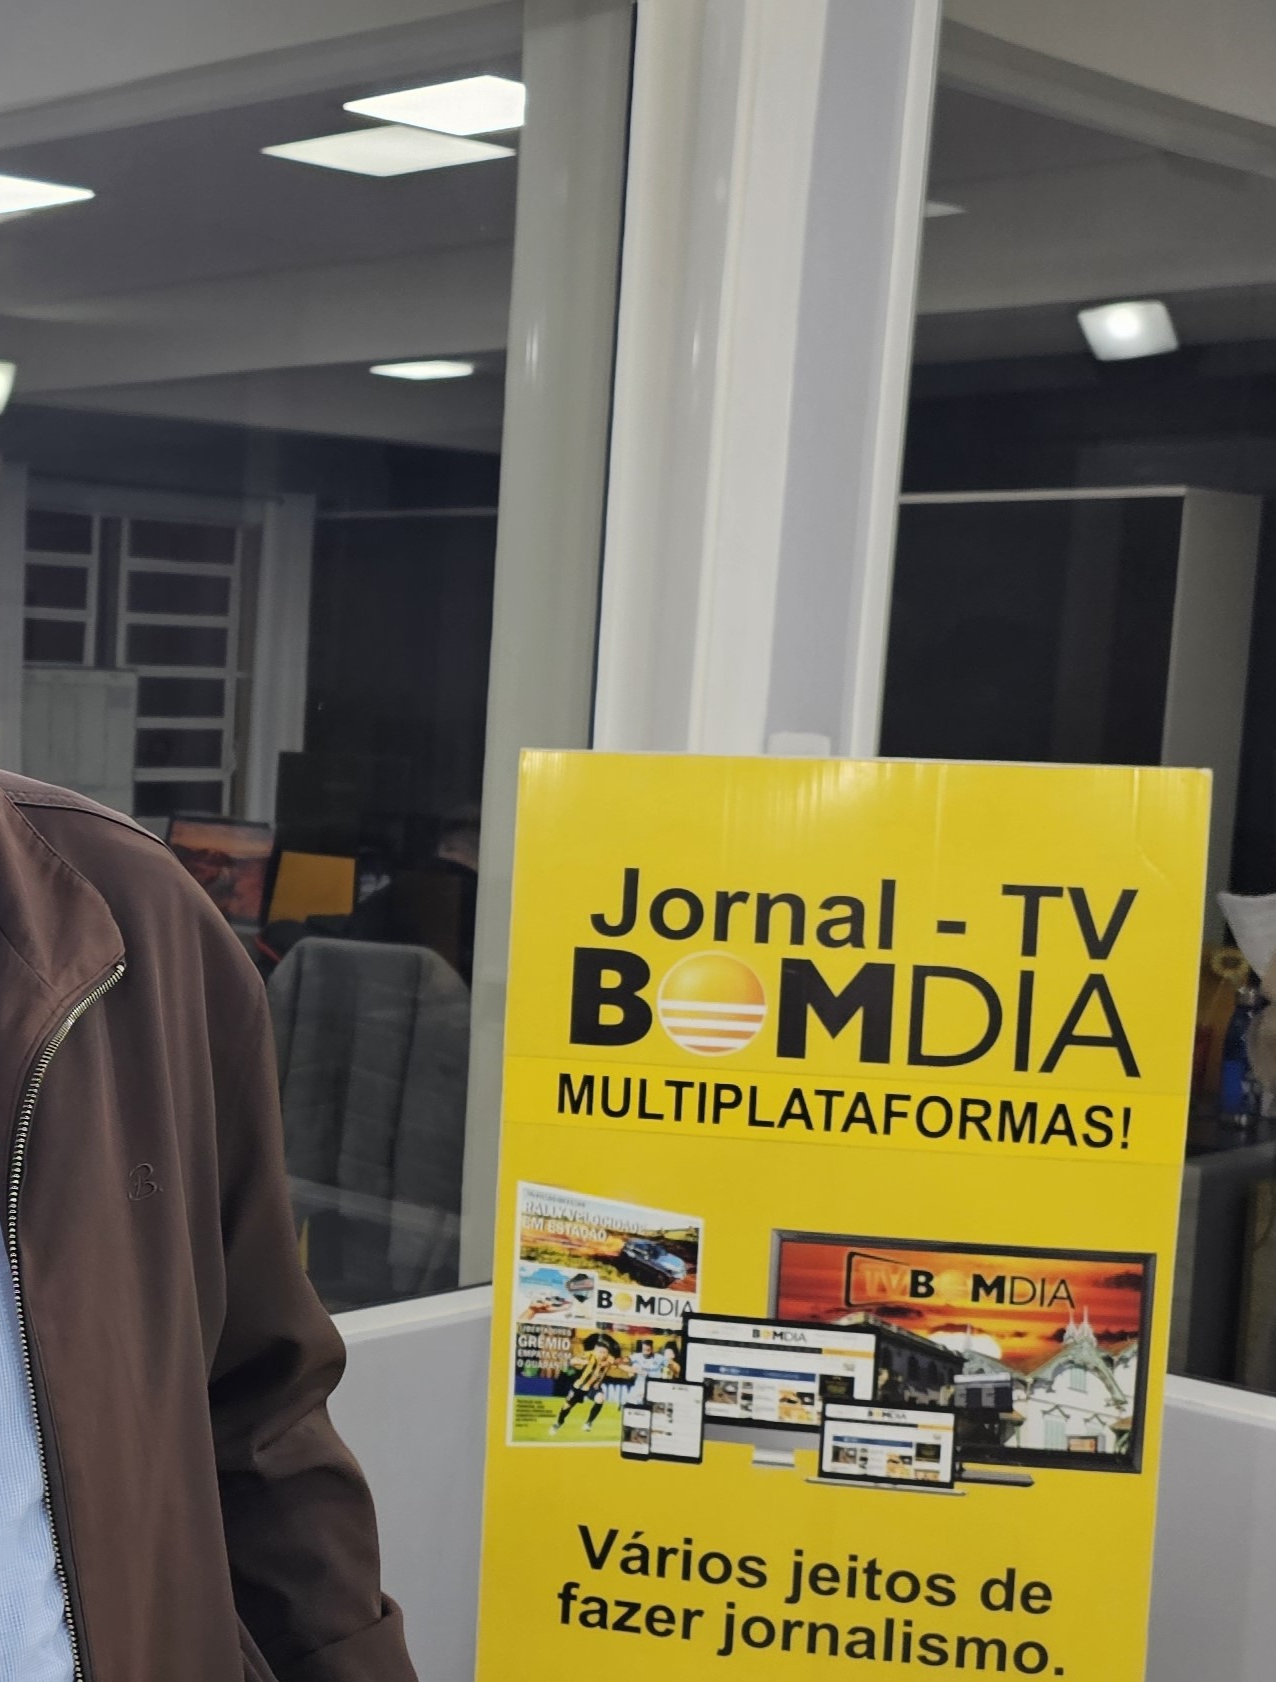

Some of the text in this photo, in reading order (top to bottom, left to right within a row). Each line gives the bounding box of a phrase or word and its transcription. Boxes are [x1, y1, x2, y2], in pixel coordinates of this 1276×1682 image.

[590, 867, 896, 950] Jornal
[1002, 884, 1139, 961] TV
[557, 1072, 1131, 1149] MULTIPLATAFORMAS!
[577, 1524, 1053, 1615] Vários jeitos de
[557, 1581, 1065, 1677] fazer jornalismo.
